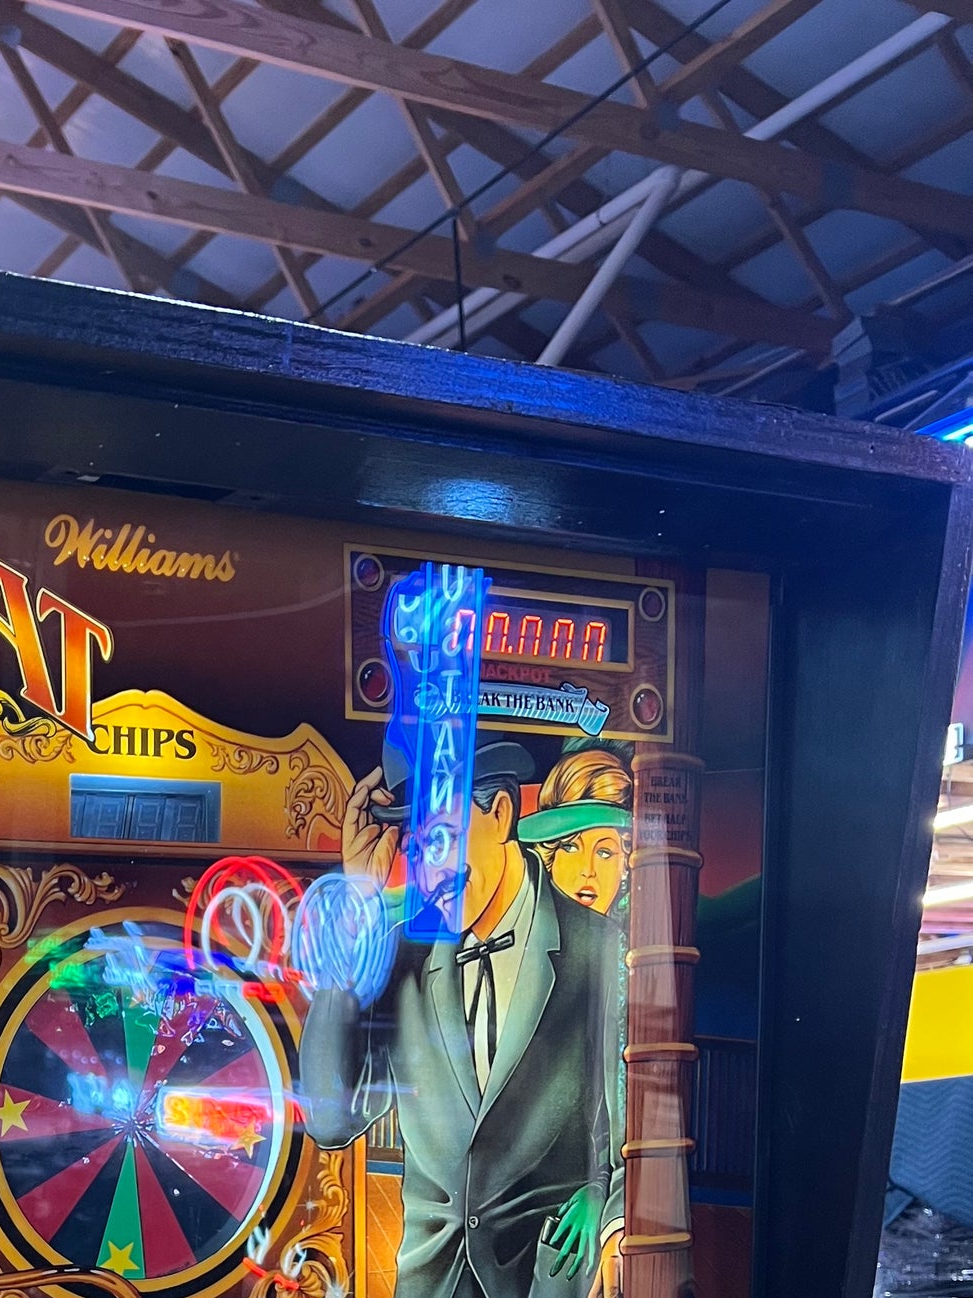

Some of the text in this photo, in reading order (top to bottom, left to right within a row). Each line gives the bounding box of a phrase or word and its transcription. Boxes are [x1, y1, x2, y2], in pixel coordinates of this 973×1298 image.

[45, 514, 235, 582] Williams
[505, 693, 532, 710] THE
[536, 695, 574, 713] BANK
[87, 723, 197, 760] CHIPS
